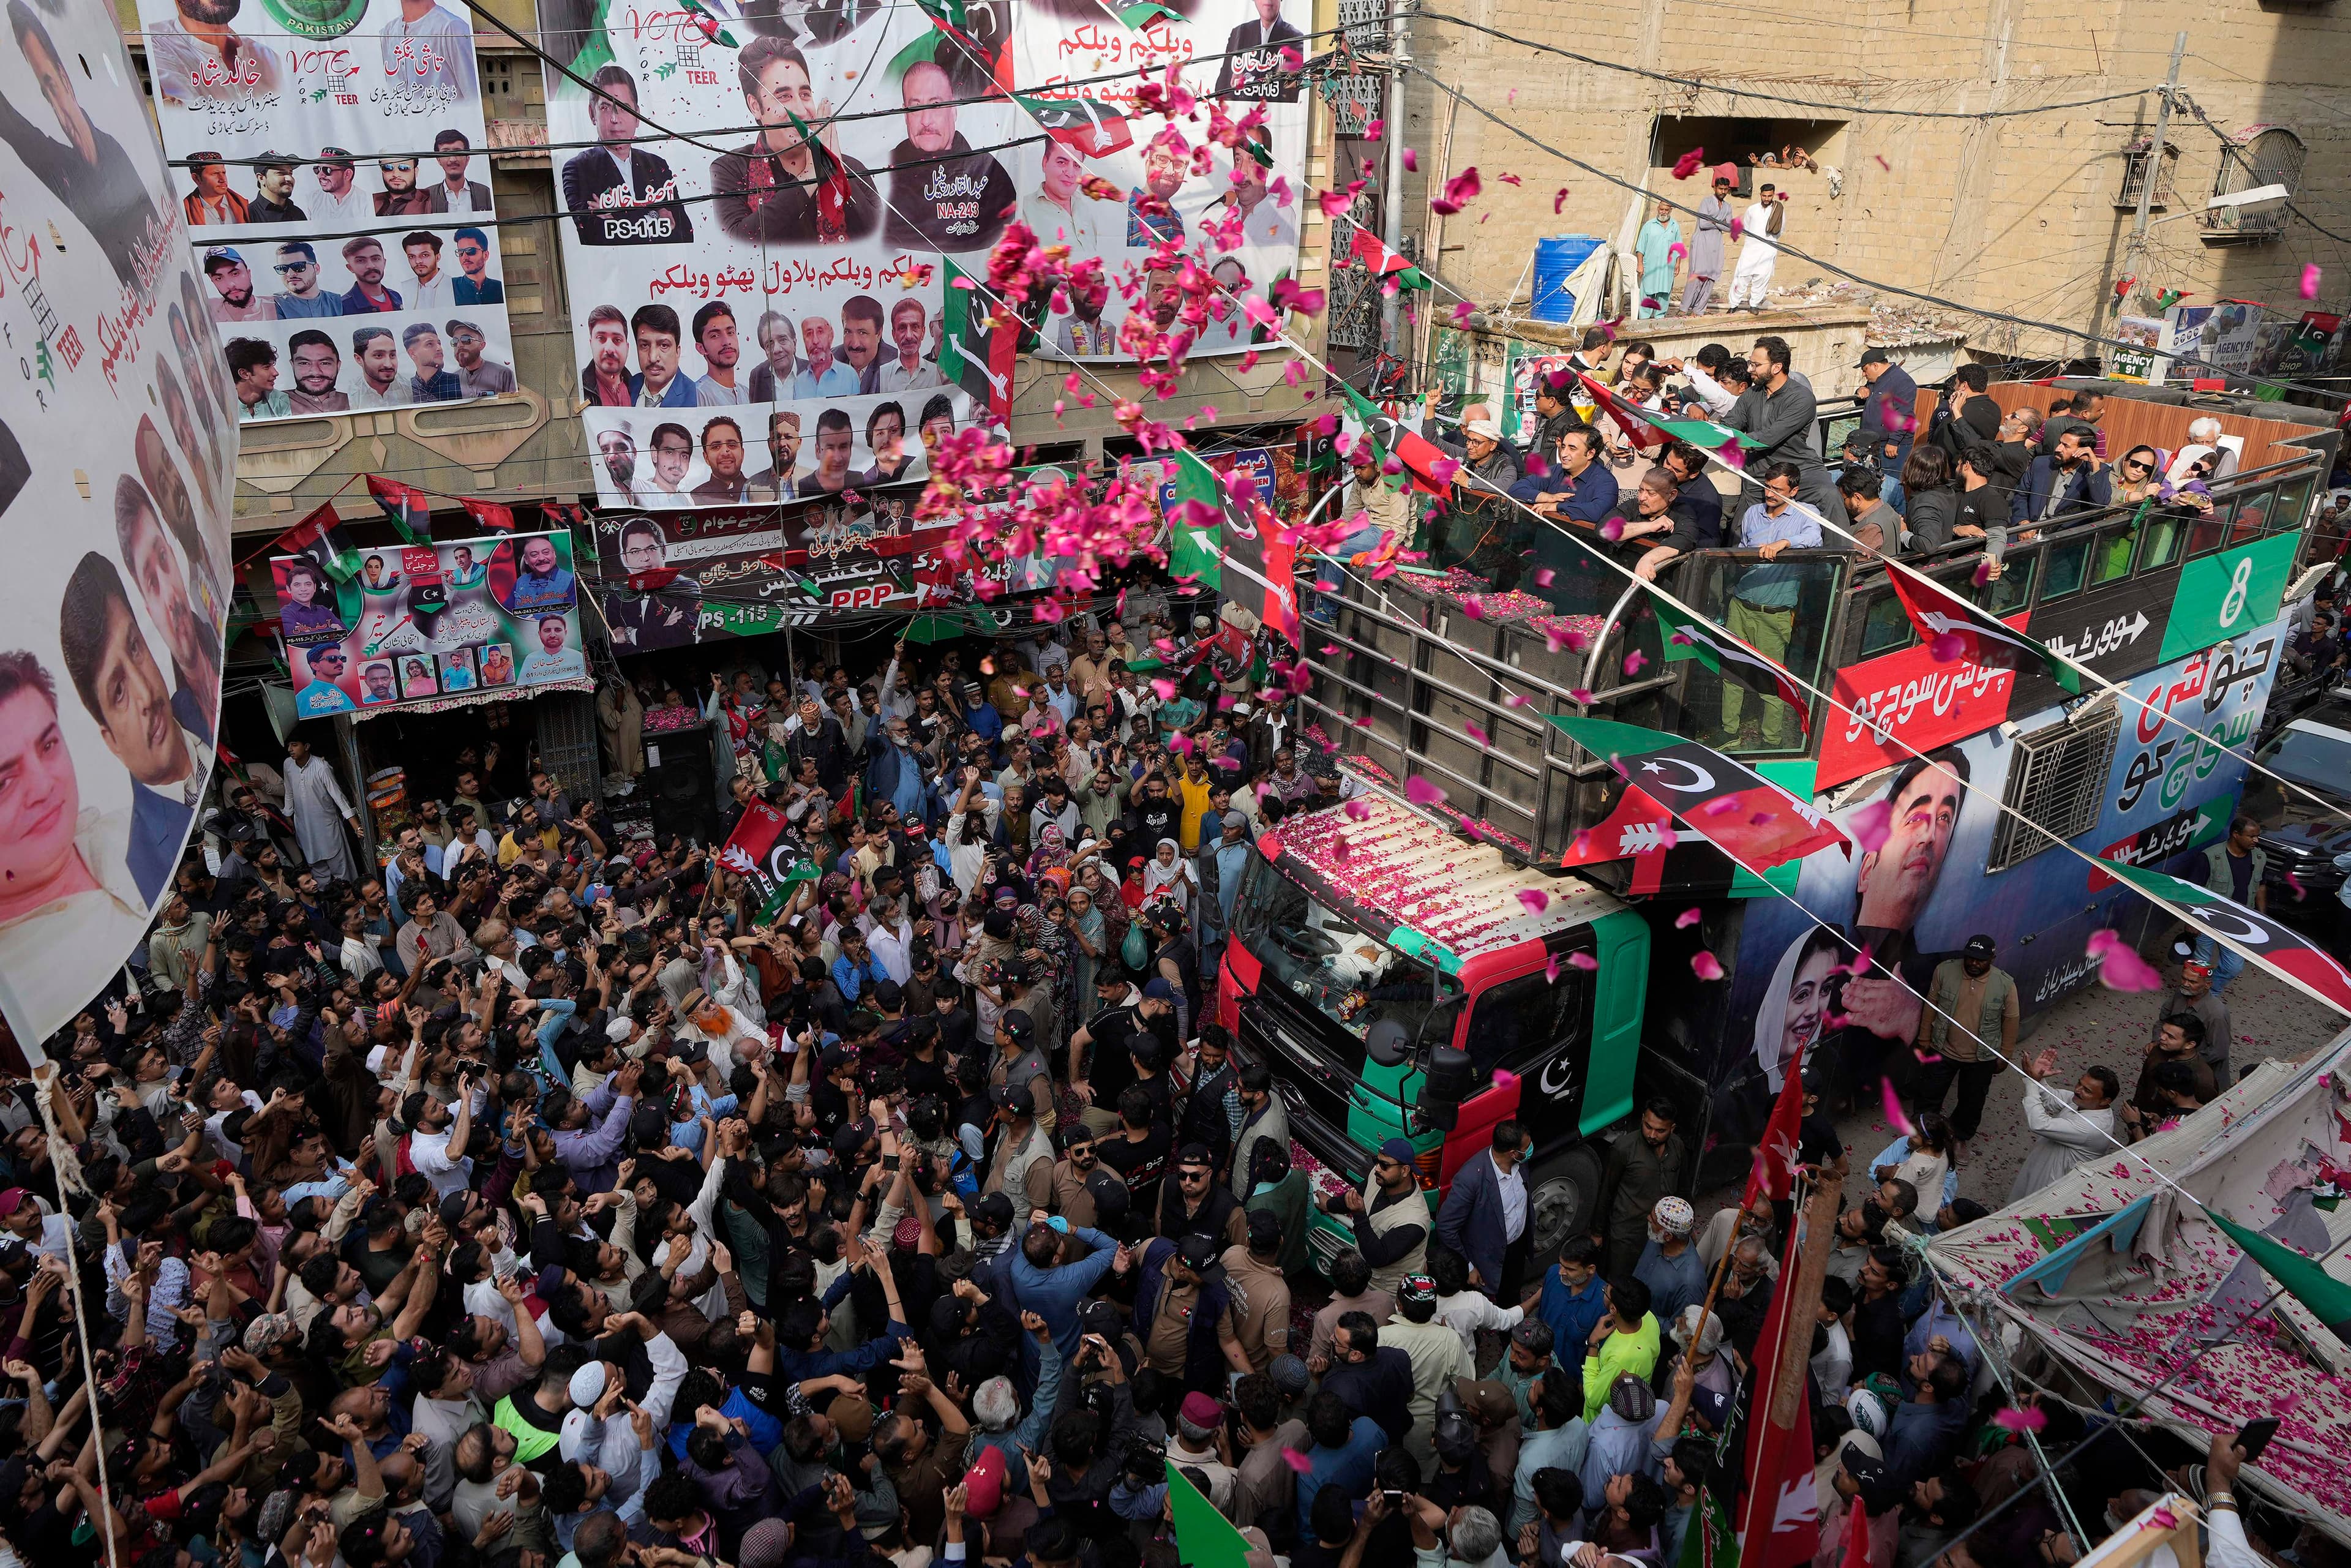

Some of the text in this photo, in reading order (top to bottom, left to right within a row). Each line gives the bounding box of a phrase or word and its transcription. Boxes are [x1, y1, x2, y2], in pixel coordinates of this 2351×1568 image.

[287, 18, 355, 35] PAKISTAN
[626, 9, 705, 43] VOTE
[1058, 24, 1193, 62] ویلکم ویلکم
[286, 50, 353, 75] VOTE
[385, 37, 414, 76] بنگش
[221, 56, 261, 86] خالد
[686, 70, 719, 84] TEER
[335, 94, 359, 105] TEER
[599, 183, 633, 209] خان
[937, 201, 979, 219] NA-243
[604, 218, 672, 239] PS-115
[650, 264, 710, 300] ویلکم
[715, 264, 755, 298] بھٹو
[763, 260, 816, 294] بلاول
[819, 257, 872, 291] ویلکم
[56, 325, 85, 373] TEER
[2113, 353, 2153, 366] AGENCY
[2216, 342, 2245, 354] AGENCY
[2245, 340, 2253, 351] 91
[2125, 365, 2136, 375] 91
[2278, 362, 2302, 370] SHOP
[703, 515, 737, 533] عوام
[405, 552, 424, 561] صرف
[832, 583, 893, 614] PPP
[2219, 557, 2252, 628] 8
[367, 613, 387, 640] تیر
[437, 615, 456, 634] پارٹی
[471, 613, 498, 629] پاکستان
[702, 611, 725, 629] PS
[383, 637, 401, 650] نشان
[532, 657, 564, 669] حنیف خان
[2203, 637, 2276, 714] چنو
[1845, 690, 1884, 743] کو
[1874, 672, 1938, 746] سوچ
[2118, 710, 2255, 812] سوچ کو
